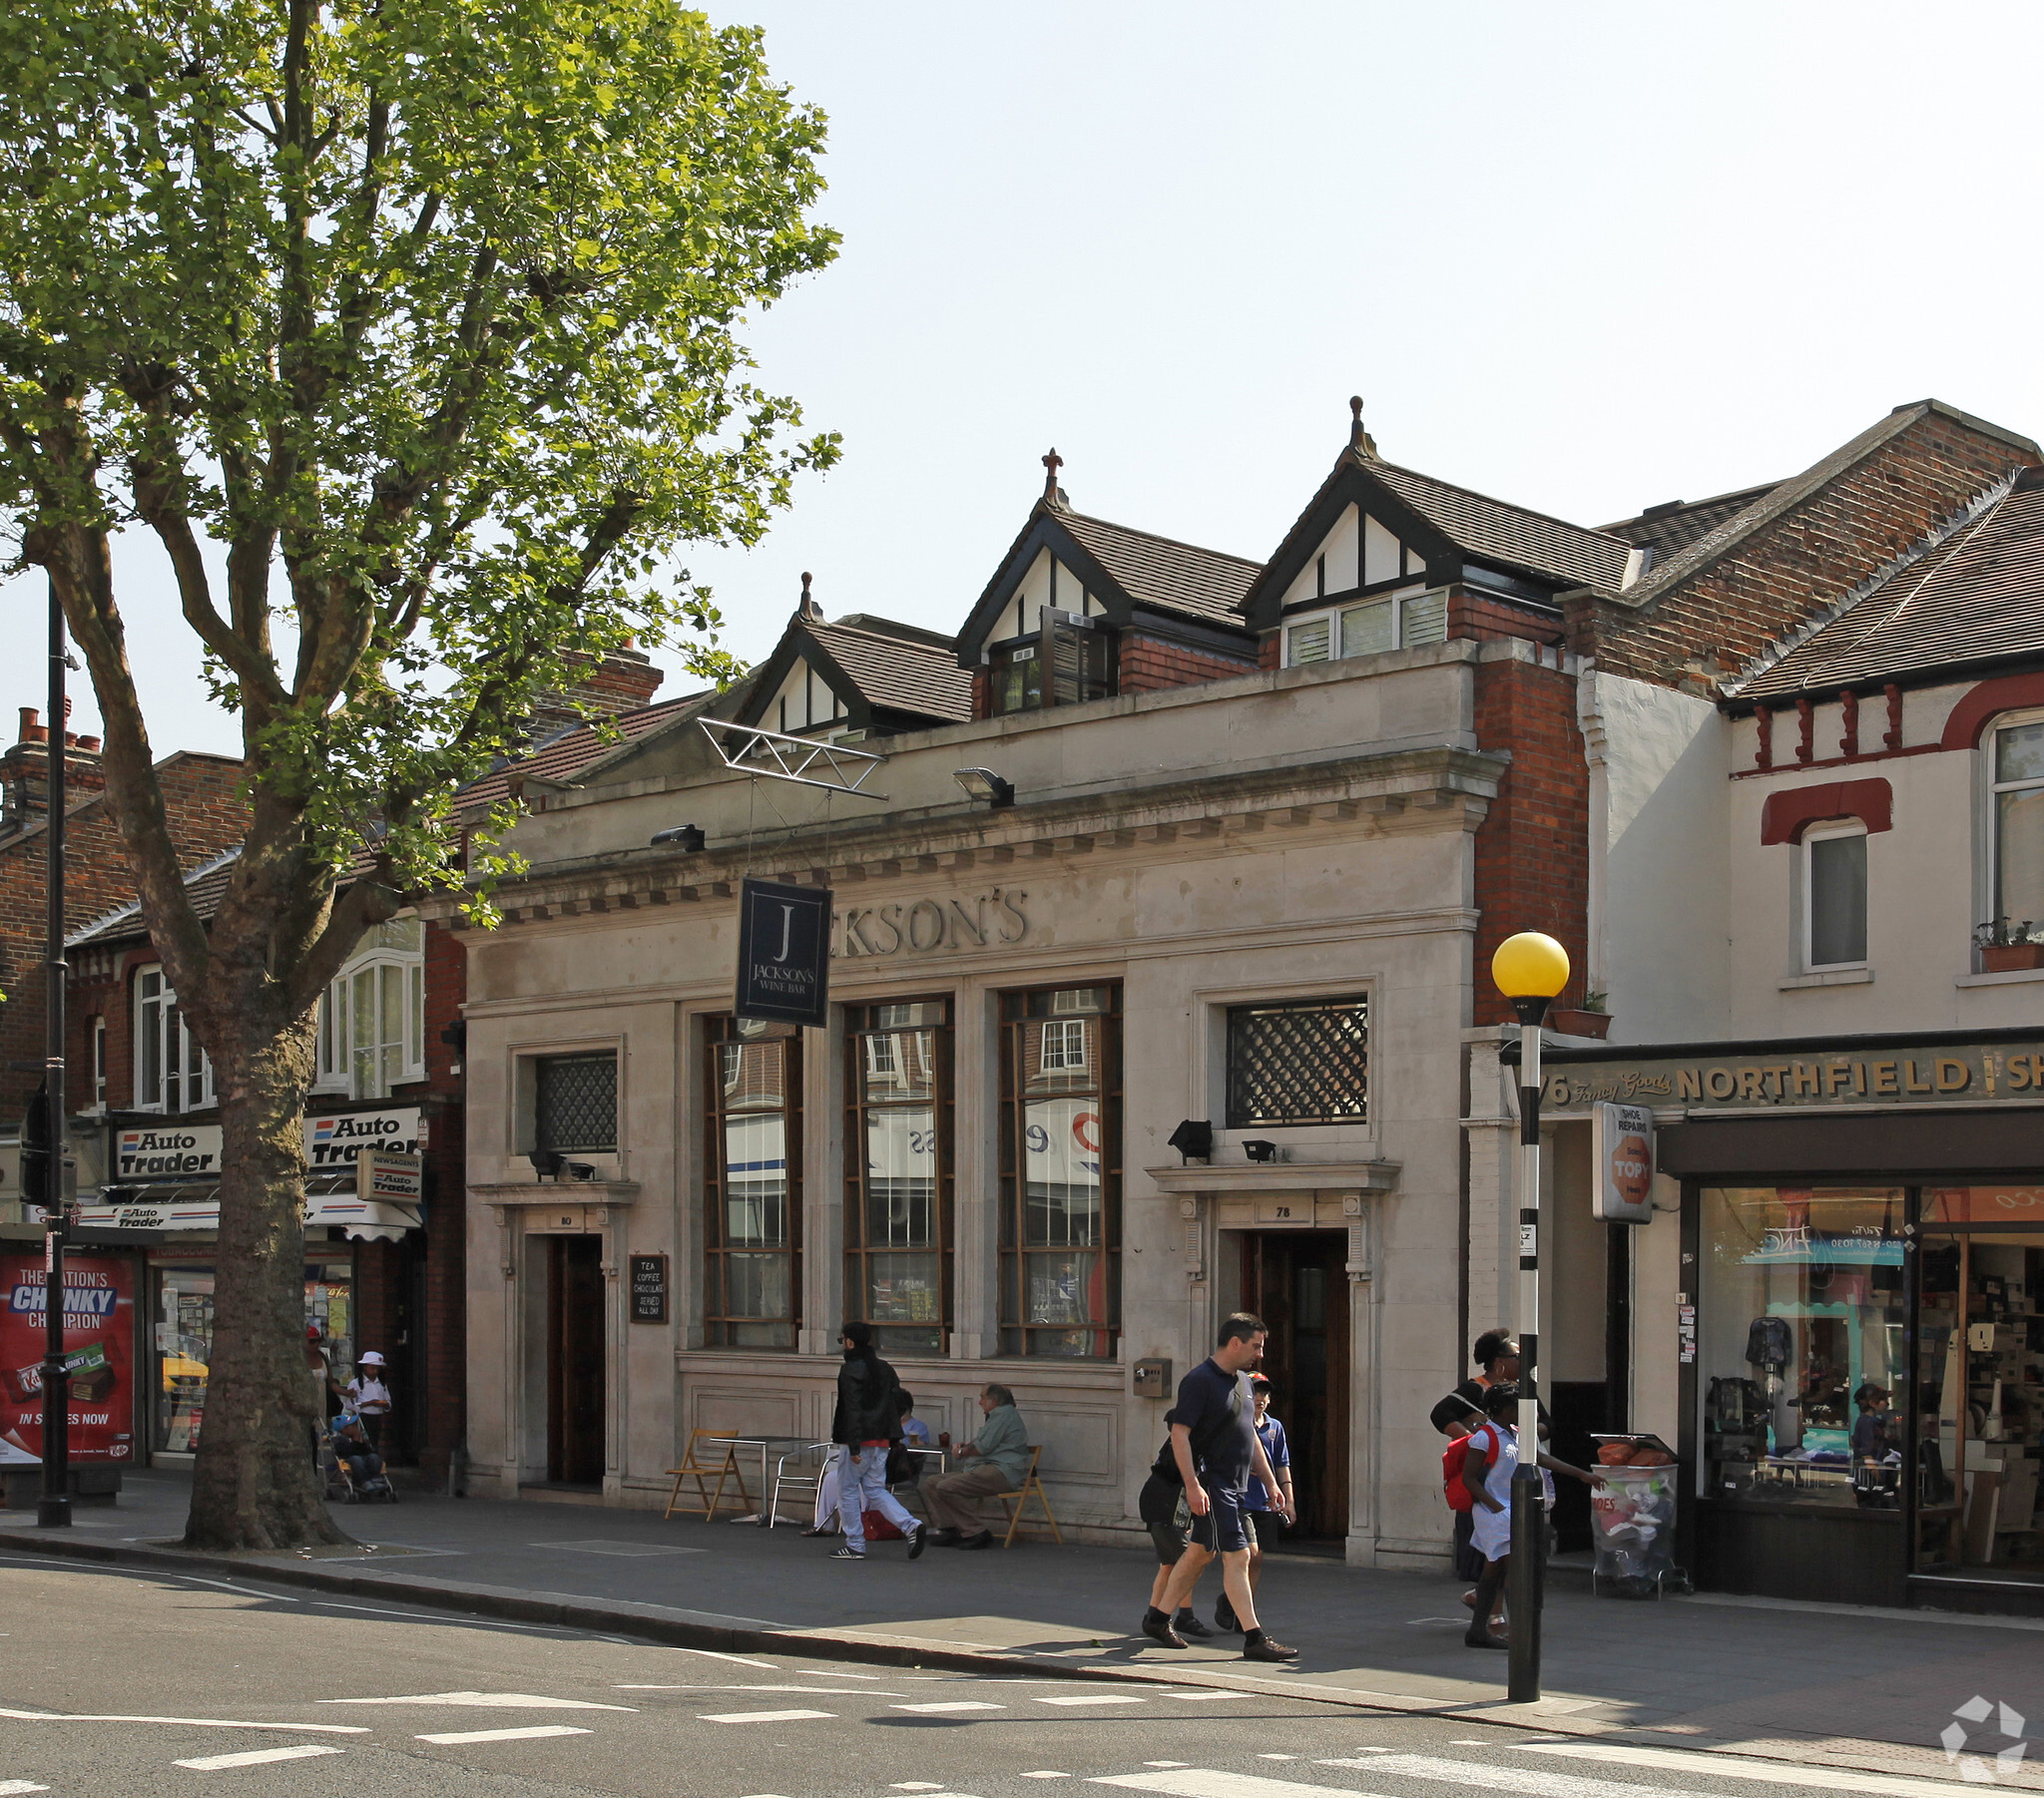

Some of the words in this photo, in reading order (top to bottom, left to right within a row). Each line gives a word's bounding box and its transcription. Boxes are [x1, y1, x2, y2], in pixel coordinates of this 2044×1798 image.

[772, 904, 795, 963] J
[753, 964, 814, 984] JACKSON'S
[760, 979, 785, 992] WINE
[787, 983, 805, 995] BAR
[1572, 1083, 1619, 1104] Fancy
[1622, 1071, 1673, 1098] Goods
[1676, 1058, 1972, 1101] NORTHFIELD
[1622, 1109, 1642, 1120] SHOE
[332, 1118, 400, 1138] Auto
[1618, 1121, 1648, 1133] REPAIRS
[138, 1132, 197, 1150] Auto
[120, 1152, 214, 1173] Trader
[373, 1156, 419, 1168] NEWSAGENTS
[1614, 1160, 1650, 1179] TOPY
[373, 1181, 419, 1193] Trader
[382, 1174, 411, 1184] Auto
[130, 1208, 158, 1217] Auto
[1277, 1206, 1290, 1218] 78
[119, 1218, 165, 1227] Trader
[20, 1269, 45, 1285] THE
[637, 1273, 660, 1282] COFFEE
[13, 1286, 113, 1313] CHNKY
[28, 1312, 101, 1329] CHPION
[19, 1414, 32, 1425] IN
[82, 1414, 109, 1425] NOW
